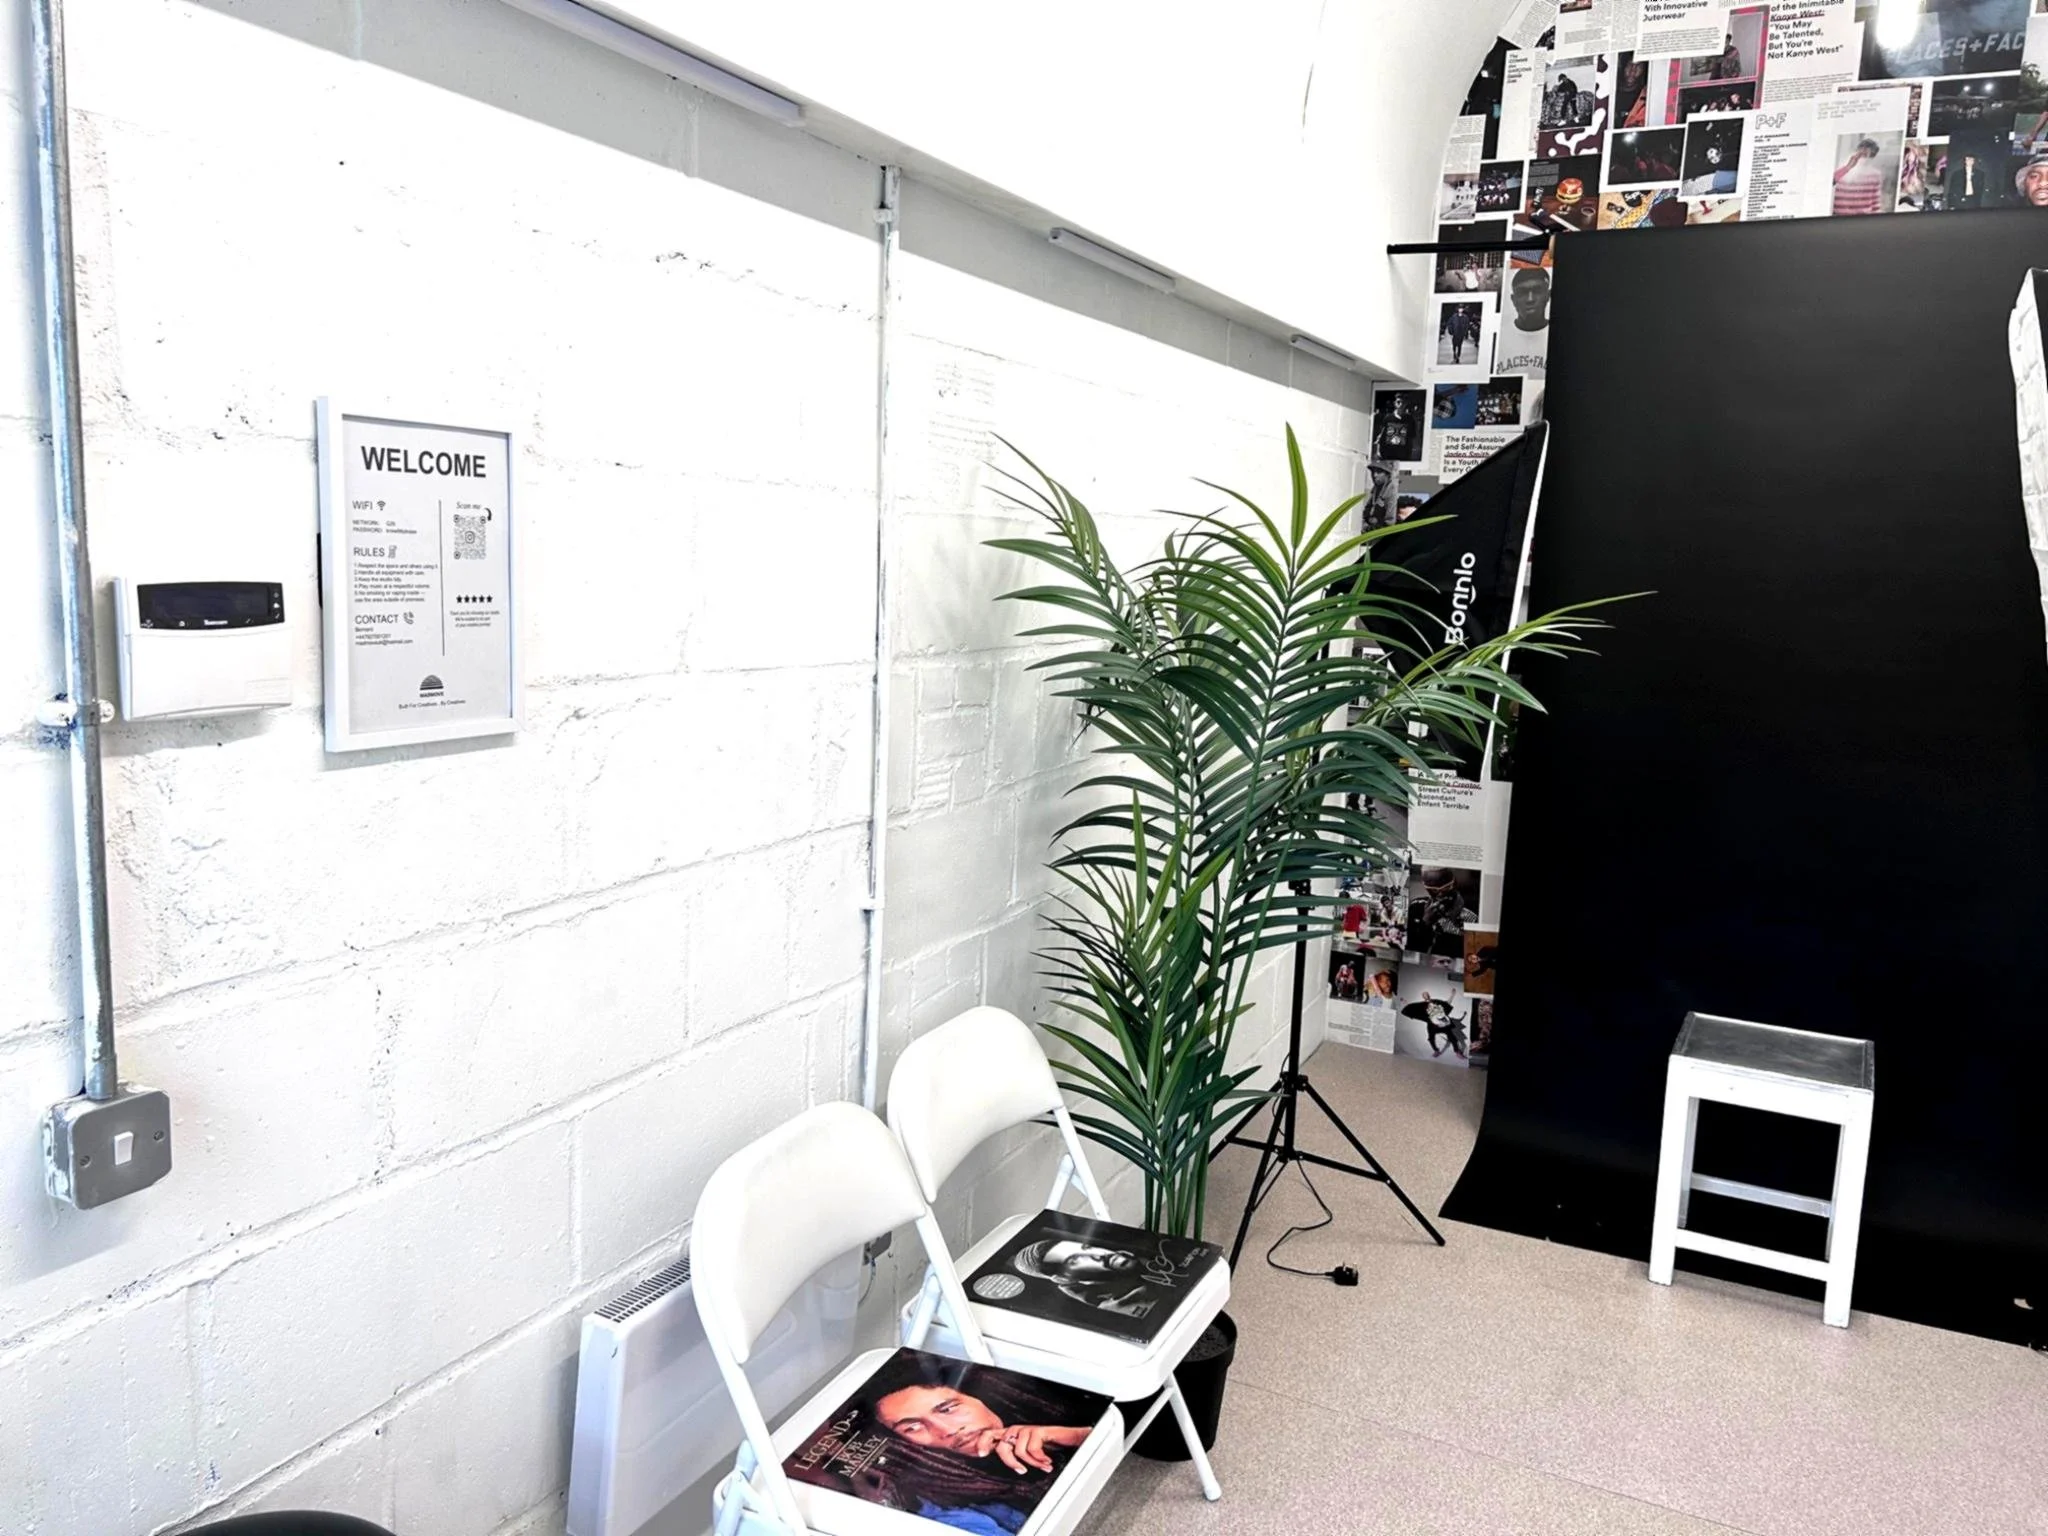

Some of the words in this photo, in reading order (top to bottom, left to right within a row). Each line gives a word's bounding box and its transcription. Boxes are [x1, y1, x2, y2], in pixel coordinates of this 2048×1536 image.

[1792, 20, 1812, 29] May
[1786, 50, 1814, 58] Kanye
[1755, 112, 1787, 130] P+F
[361, 446, 487, 479] WELCOME
[352, 500, 373, 510] WIFI
[353, 547, 385, 557] RULES
[1444, 552, 1476, 646] Bonnlo
[355, 614, 399, 625] CONTACT
[794, 1420, 851, 1470] LEGEND
[838, 1435, 881, 1476] MARLEY
